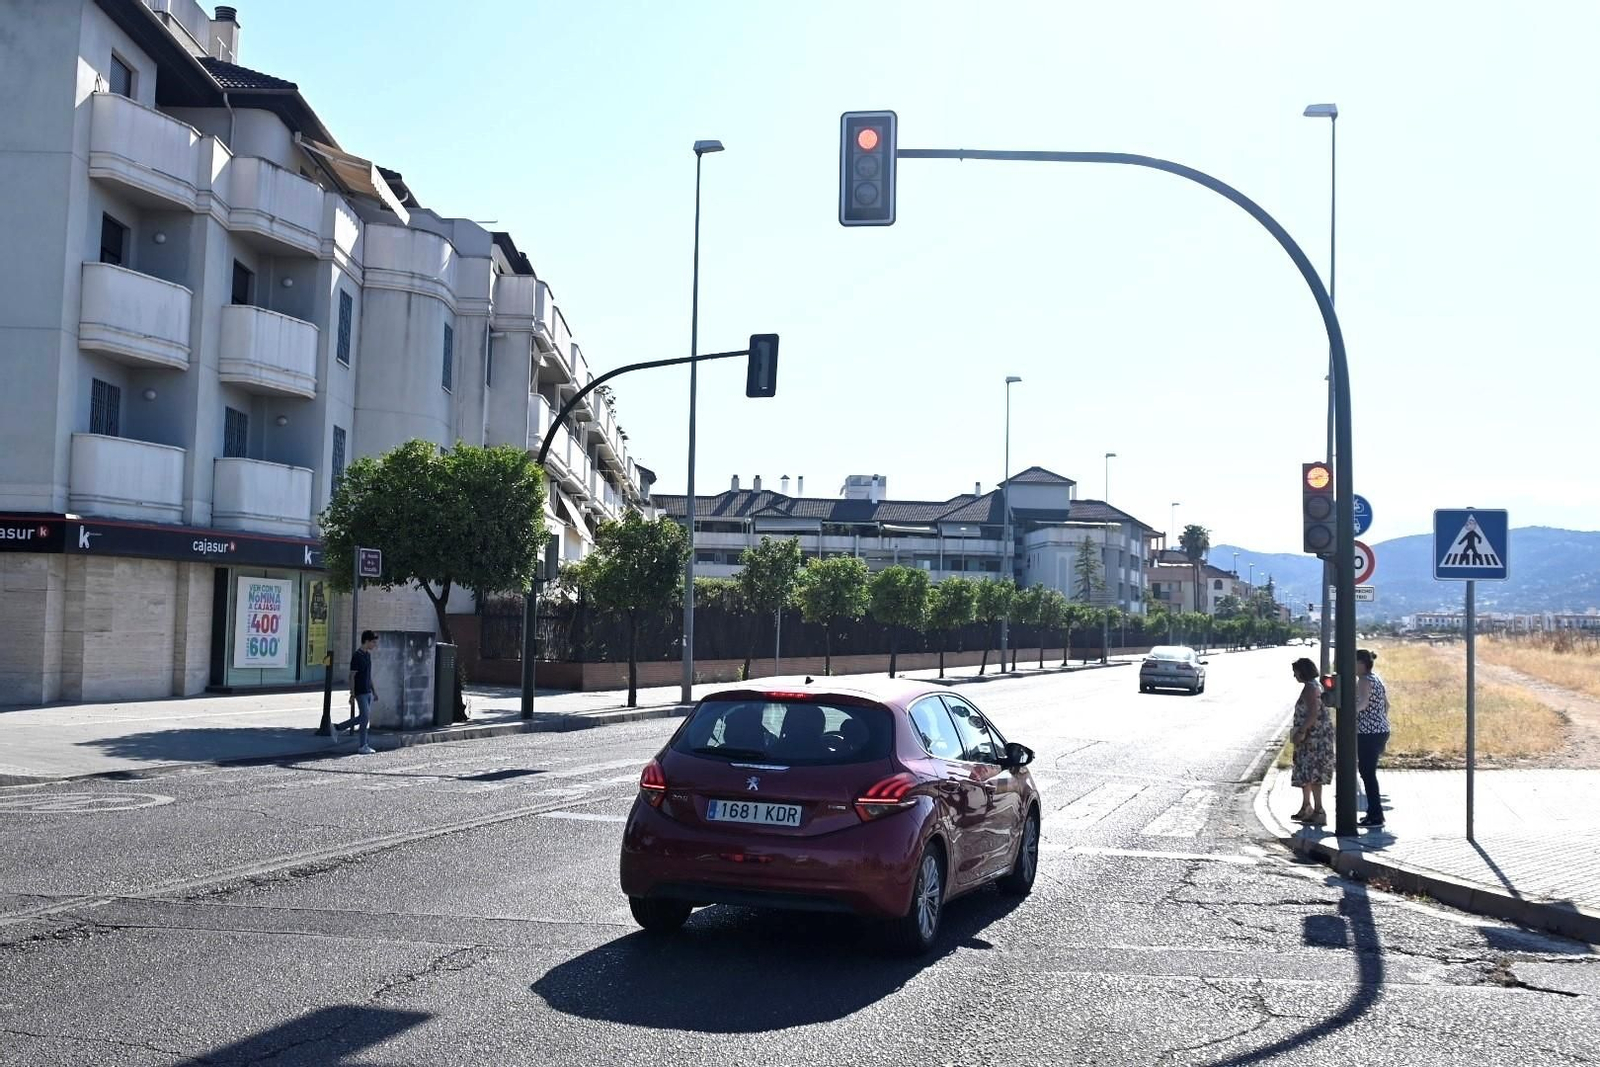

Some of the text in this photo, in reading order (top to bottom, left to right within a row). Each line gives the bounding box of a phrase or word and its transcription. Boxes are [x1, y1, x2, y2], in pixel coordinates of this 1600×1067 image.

[192, 538, 229, 555] cajasur
[261, 584, 273, 593] CON
[274, 585, 282, 594] TU
[254, 603, 281, 612] CAJASUR
[721, 802, 798, 823] 1681 KDR
